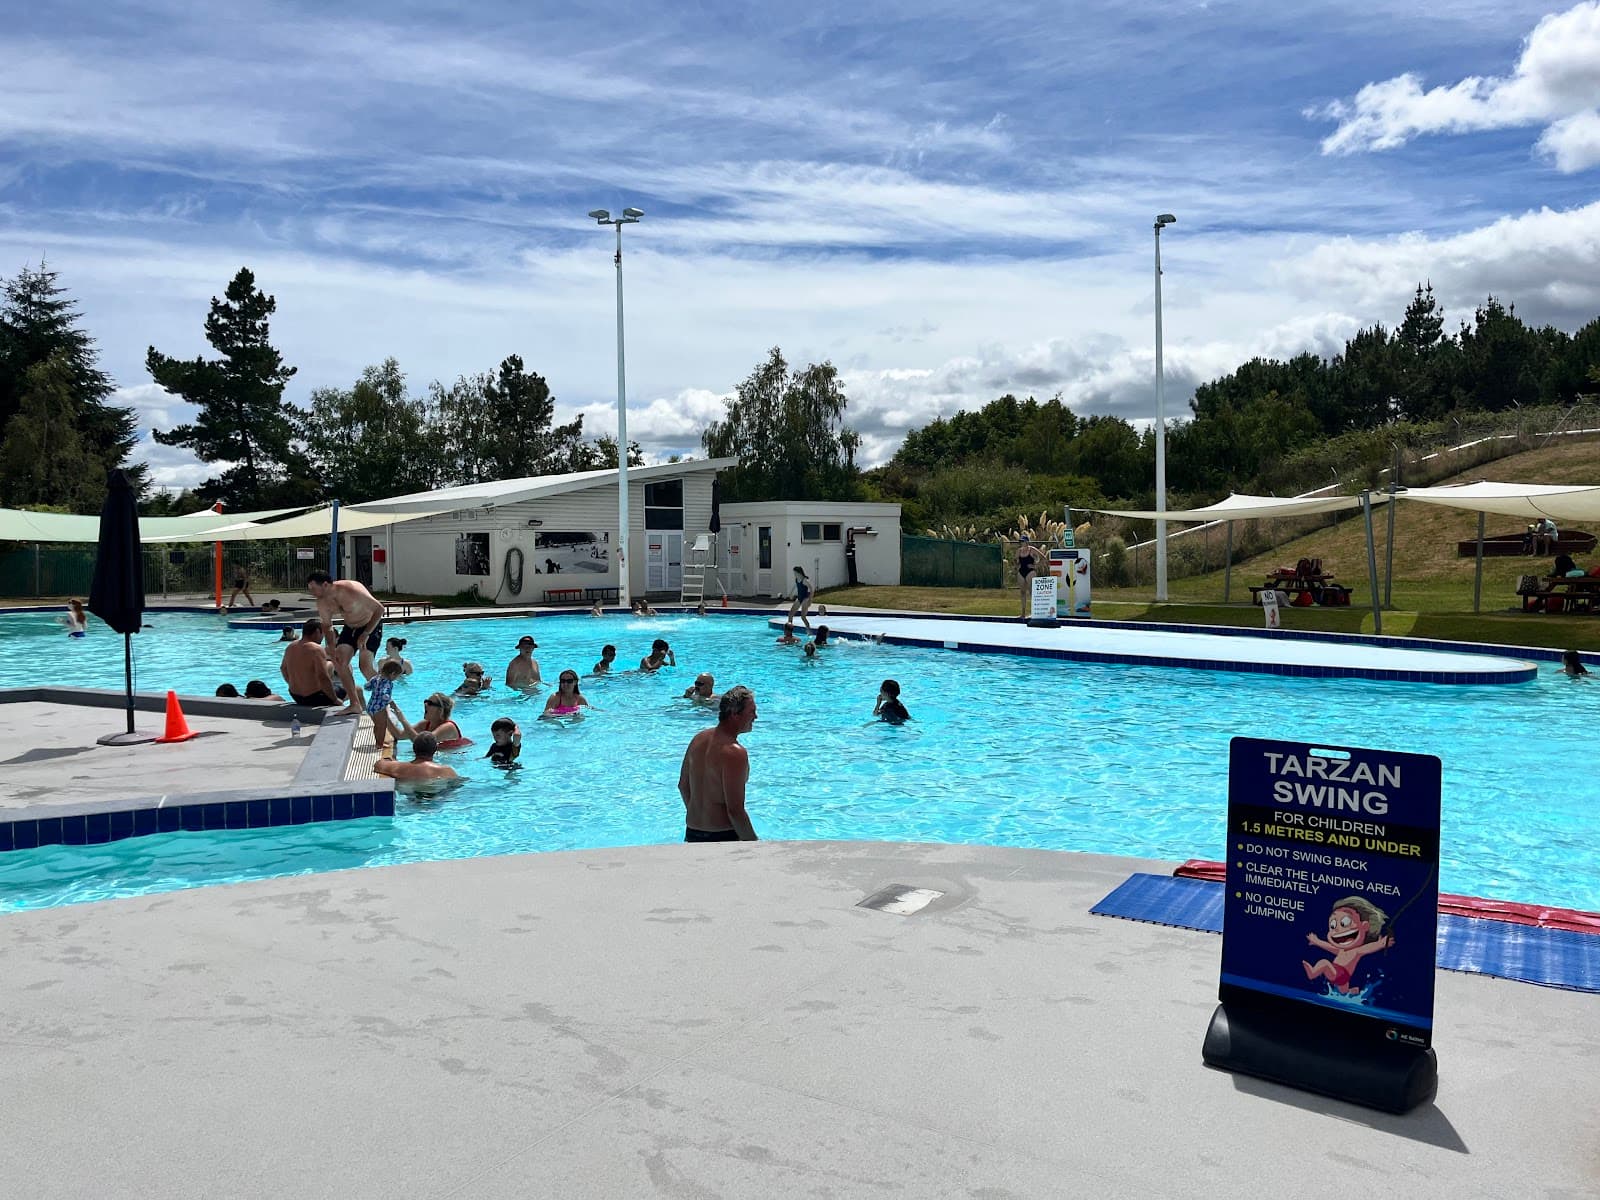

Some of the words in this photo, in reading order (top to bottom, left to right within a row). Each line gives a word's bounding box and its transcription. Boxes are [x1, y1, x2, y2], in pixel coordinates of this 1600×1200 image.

[1264, 592, 1274, 600] NO
[1264, 752, 1400, 788] TARZAN
[1273, 781, 1388, 814] SWING
[1274, 812, 1304, 826] FOR
[1308, 816, 1385, 836] CHILDREN
[1242, 821, 1260, 833] 1.5
[1264, 824, 1324, 842] METRES
[1327, 834, 1360, 848] AND
[1365, 839, 1420, 856] UNDER
[1246, 844, 1263, 854] DO
[1266, 846, 1289, 858] NOT
[1292, 851, 1332, 866] SWING
[1334, 858, 1368, 872] BACK
[1246, 862, 1282, 876] CLEAR
[1286, 868, 1308, 880] THE
[1312, 872, 1364, 890] LANDING
[1367, 882, 1400, 896] AREA
[1246, 874, 1320, 894] IMMEDIATELY
[1244, 905, 1294, 922] JUMPING
[1246, 892, 1261, 902] NO
[1264, 896, 1304, 912] QUEUE
